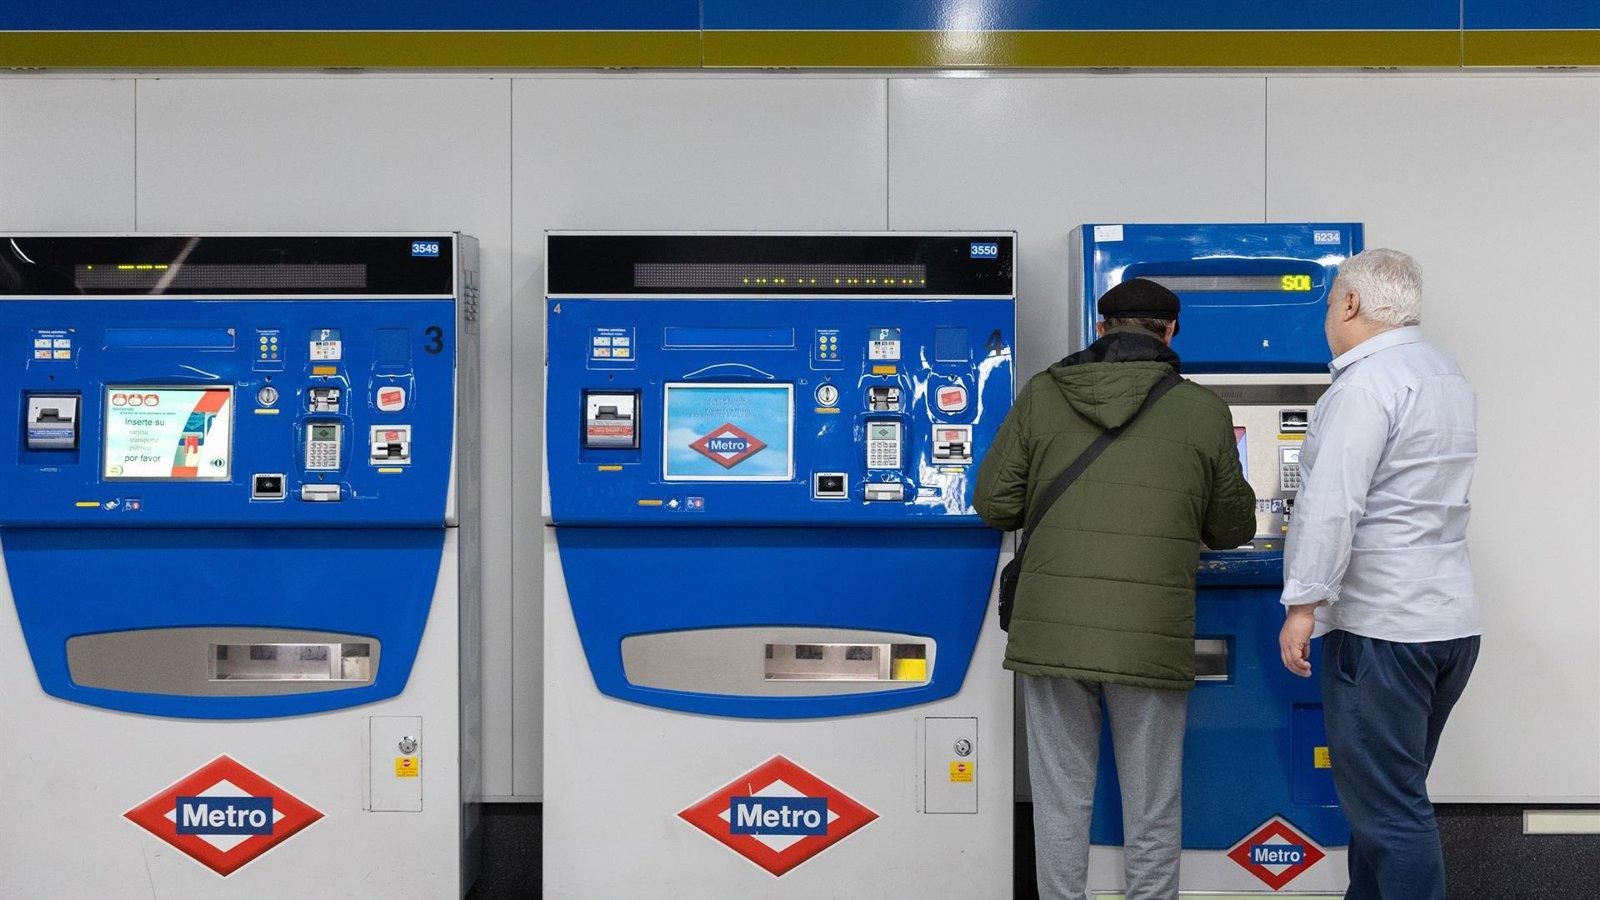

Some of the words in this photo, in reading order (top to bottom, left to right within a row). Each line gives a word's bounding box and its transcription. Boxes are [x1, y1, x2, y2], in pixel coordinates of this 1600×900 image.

[1314, 232, 1340, 242] 6234
[412, 243, 439, 254] 3549
[971, 245, 998, 256] 3550
[553, 303, 562, 315] 4
[424, 325, 445, 355] 3
[125, 418, 153, 426] Inserte
[711, 440, 745, 451] Metro
[140, 454, 161, 462] favor
[182, 803, 267, 829] Metro
[737, 803, 821, 828] Metro
[1254, 848, 1301, 862] Metro
